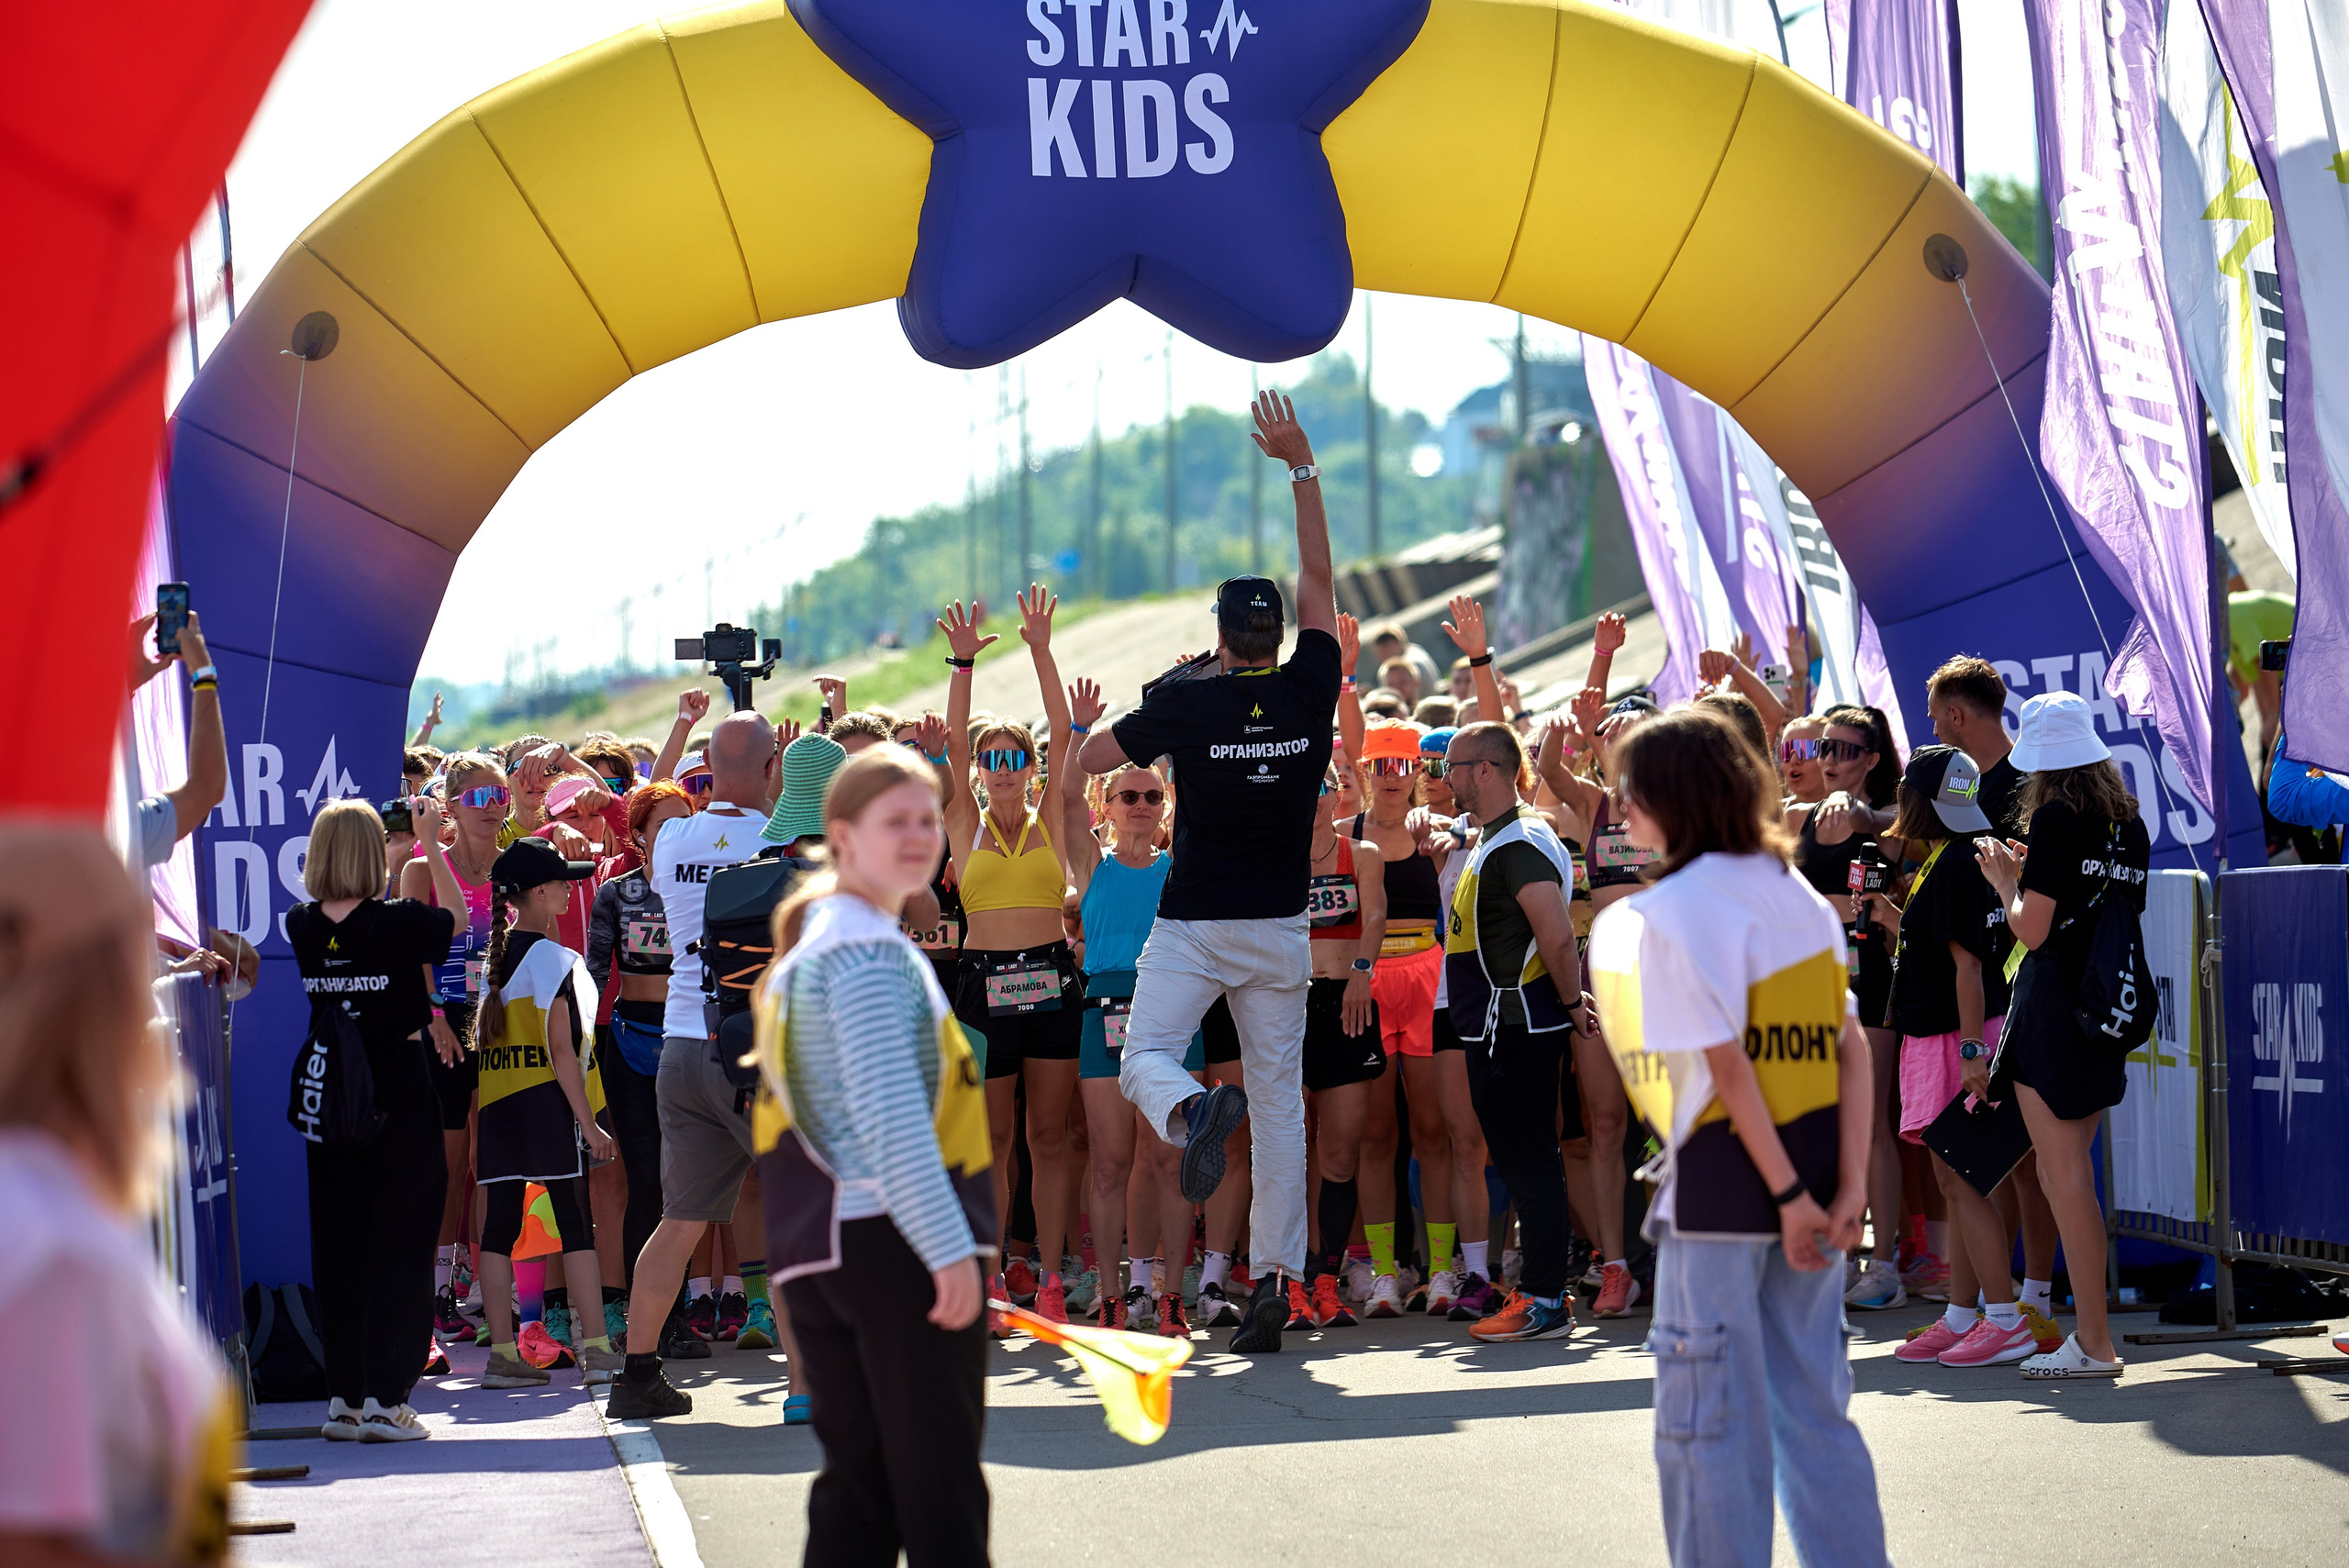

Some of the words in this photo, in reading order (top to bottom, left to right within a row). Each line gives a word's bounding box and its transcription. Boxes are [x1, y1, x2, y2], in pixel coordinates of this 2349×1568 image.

[1026, 0, 1191, 68] STAR
[1027, 72, 1235, 179] KIDS
[1209, 738, 1309, 759] ОРГАНИЗАТОР
[1948, 776, 1971, 790] IRON
[1865, 871, 1879, 879] IRON
[1865, 878, 1883, 888] LADY
[640, 926, 671, 948] 74
[302, 974, 390, 993] ОРГАНИЗАТОР
[1000, 981, 1048, 995] АБРАМОВА
[2252, 983, 2282, 1061] STAR
[2294, 983, 2323, 1063] KIDS
[297, 1039, 328, 1143] Haier
[2028, 1366, 2070, 1376] crocs
